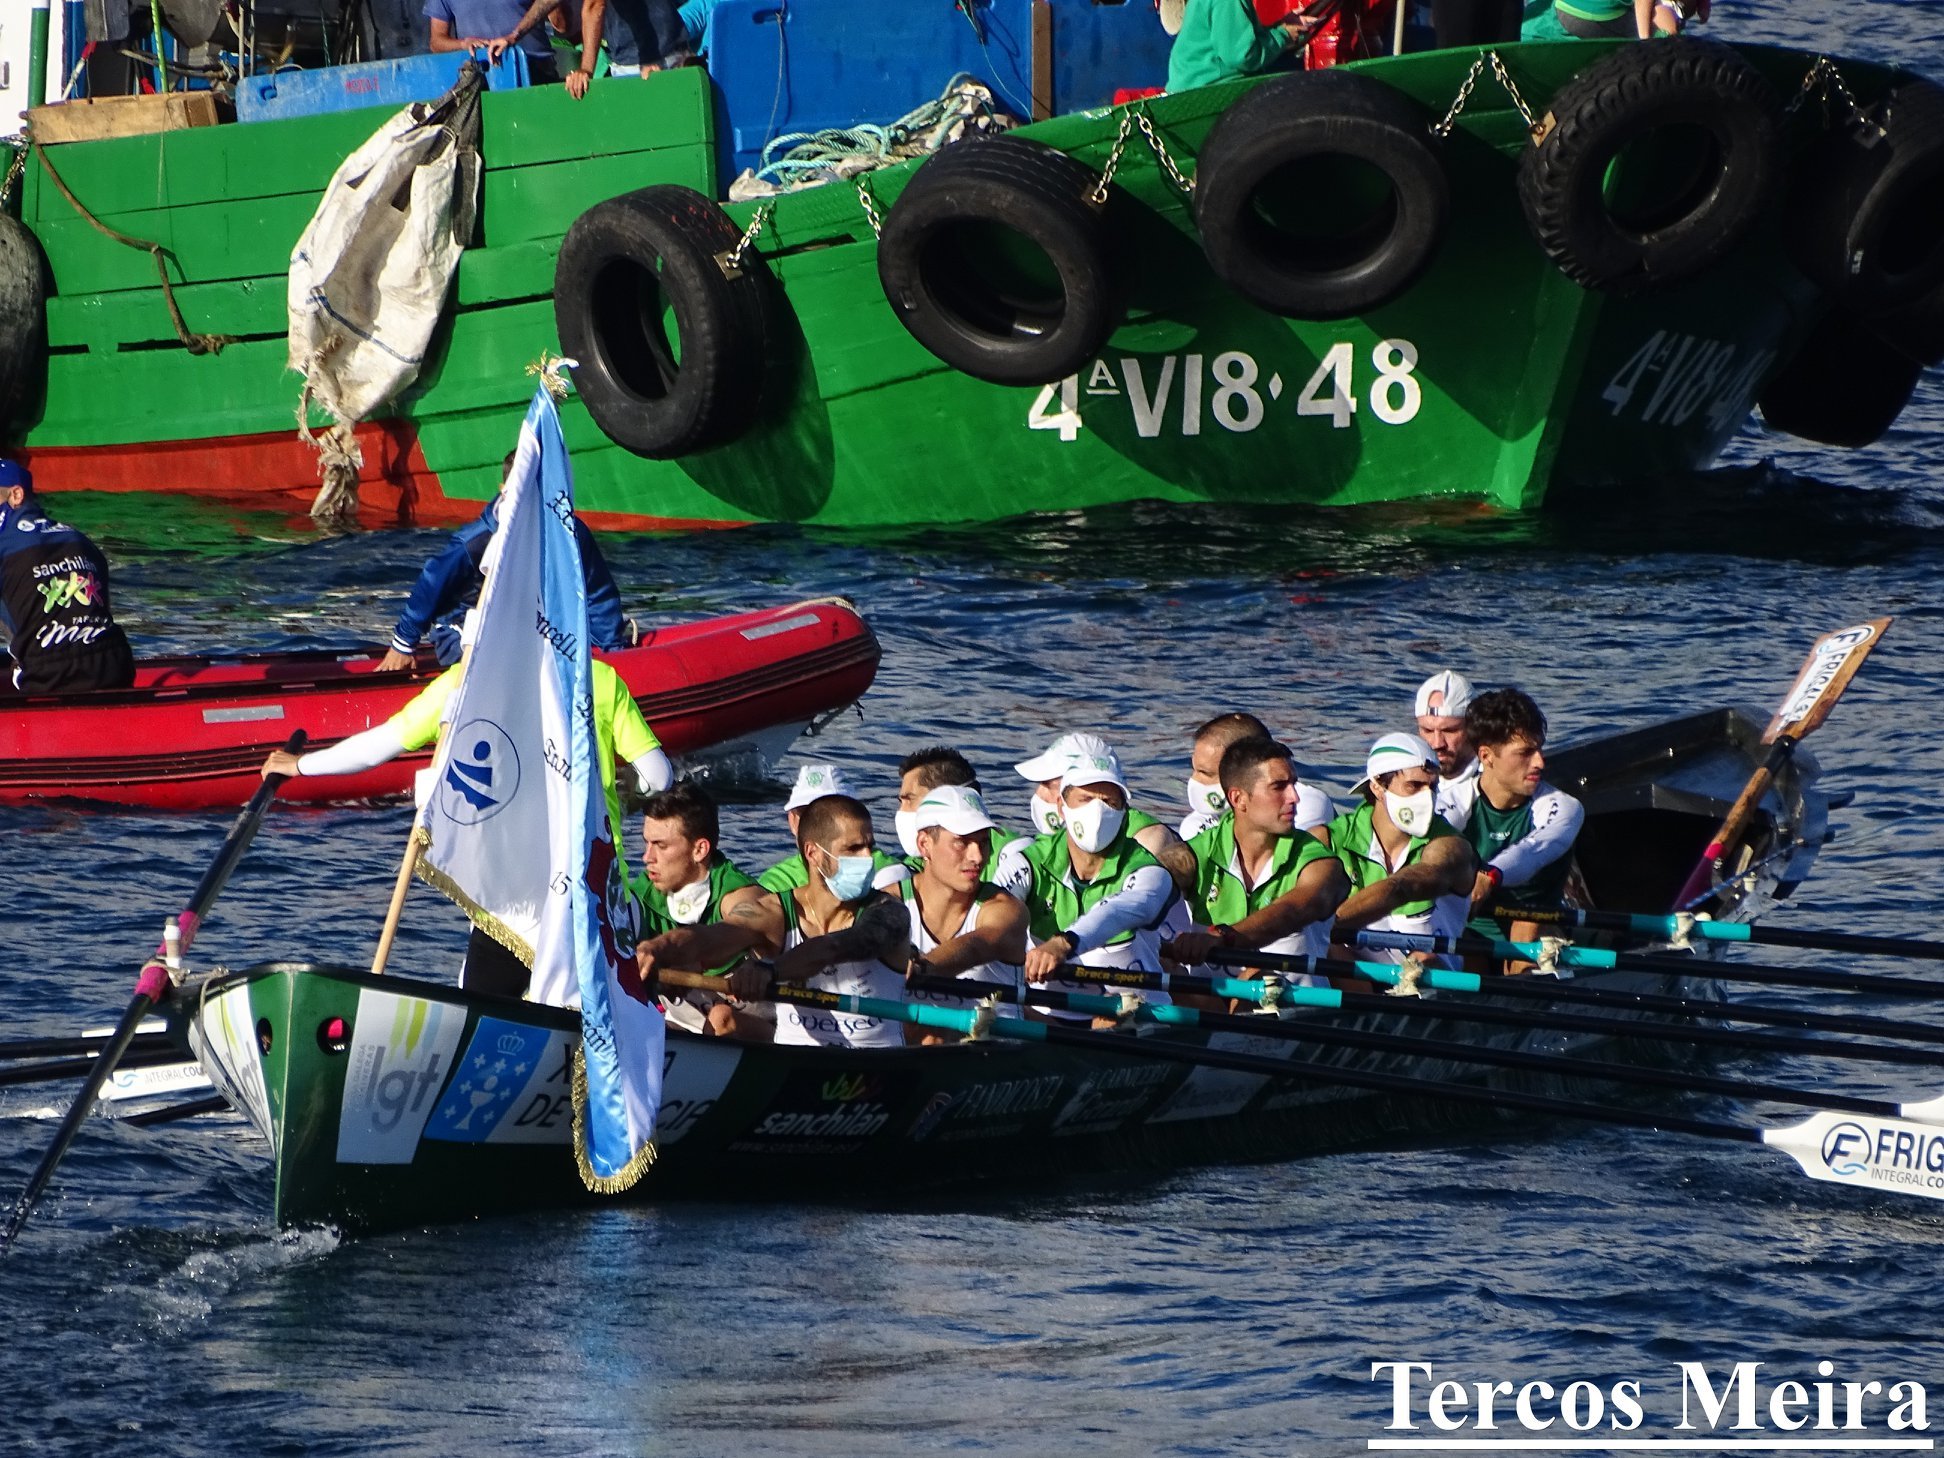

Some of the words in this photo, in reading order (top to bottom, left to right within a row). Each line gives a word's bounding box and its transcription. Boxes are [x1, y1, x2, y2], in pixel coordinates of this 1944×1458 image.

[364, 1046, 441, 1134] lgt
[514, 1093, 571, 1129] DE
[753, 1102, 891, 1136] sanchilán
